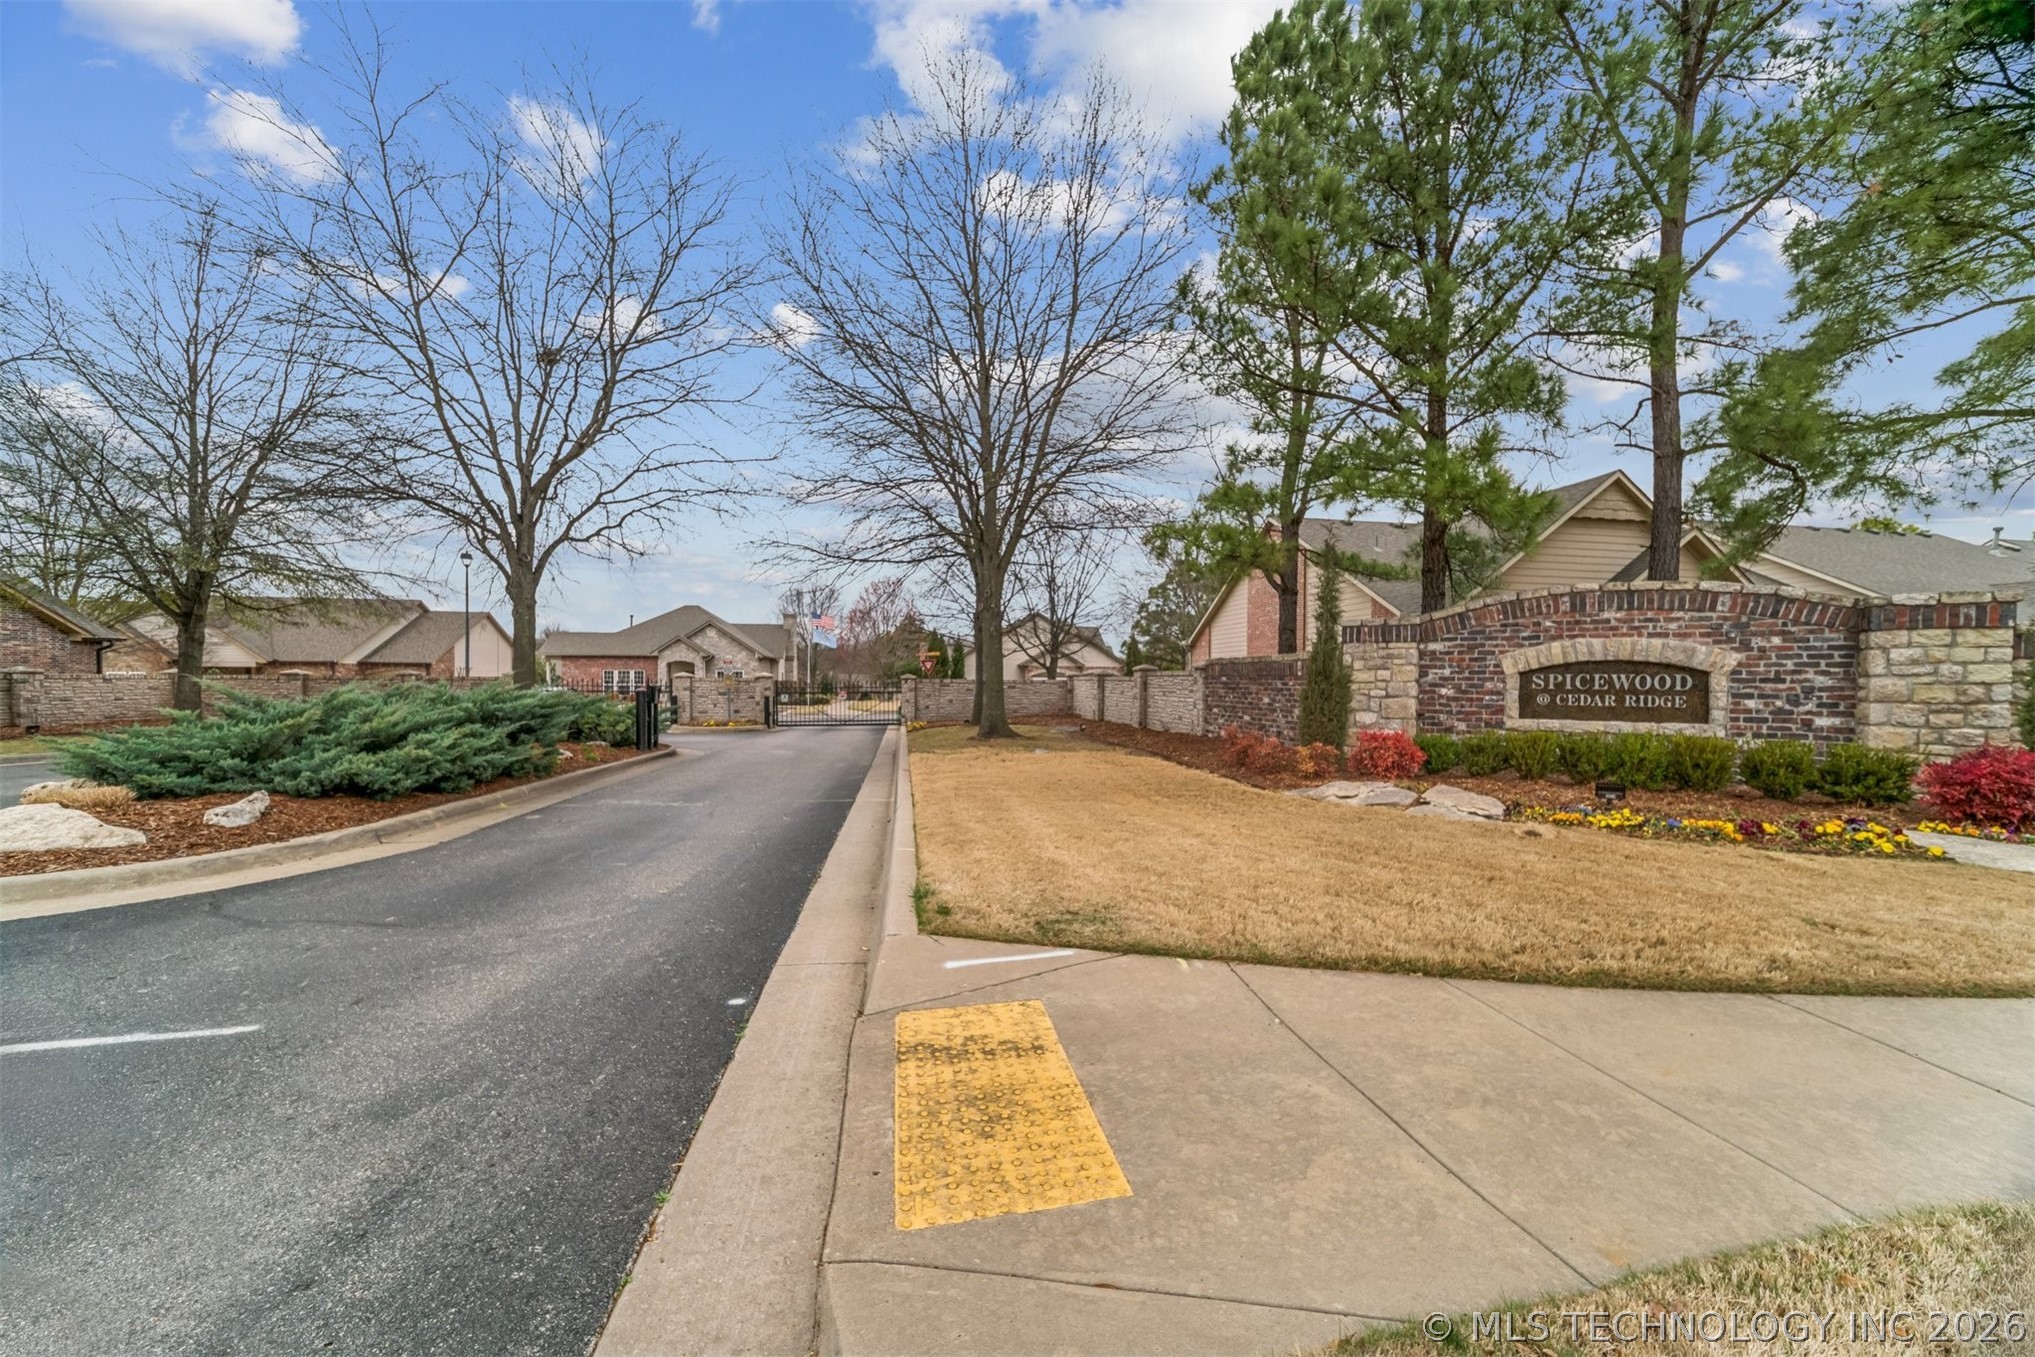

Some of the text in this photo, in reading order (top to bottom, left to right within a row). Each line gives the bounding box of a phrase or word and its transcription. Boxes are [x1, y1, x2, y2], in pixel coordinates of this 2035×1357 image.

[1531, 673, 1693, 691] SPICEWOOD
[1536, 693, 1687, 709] @ CEDAR RIDGE
